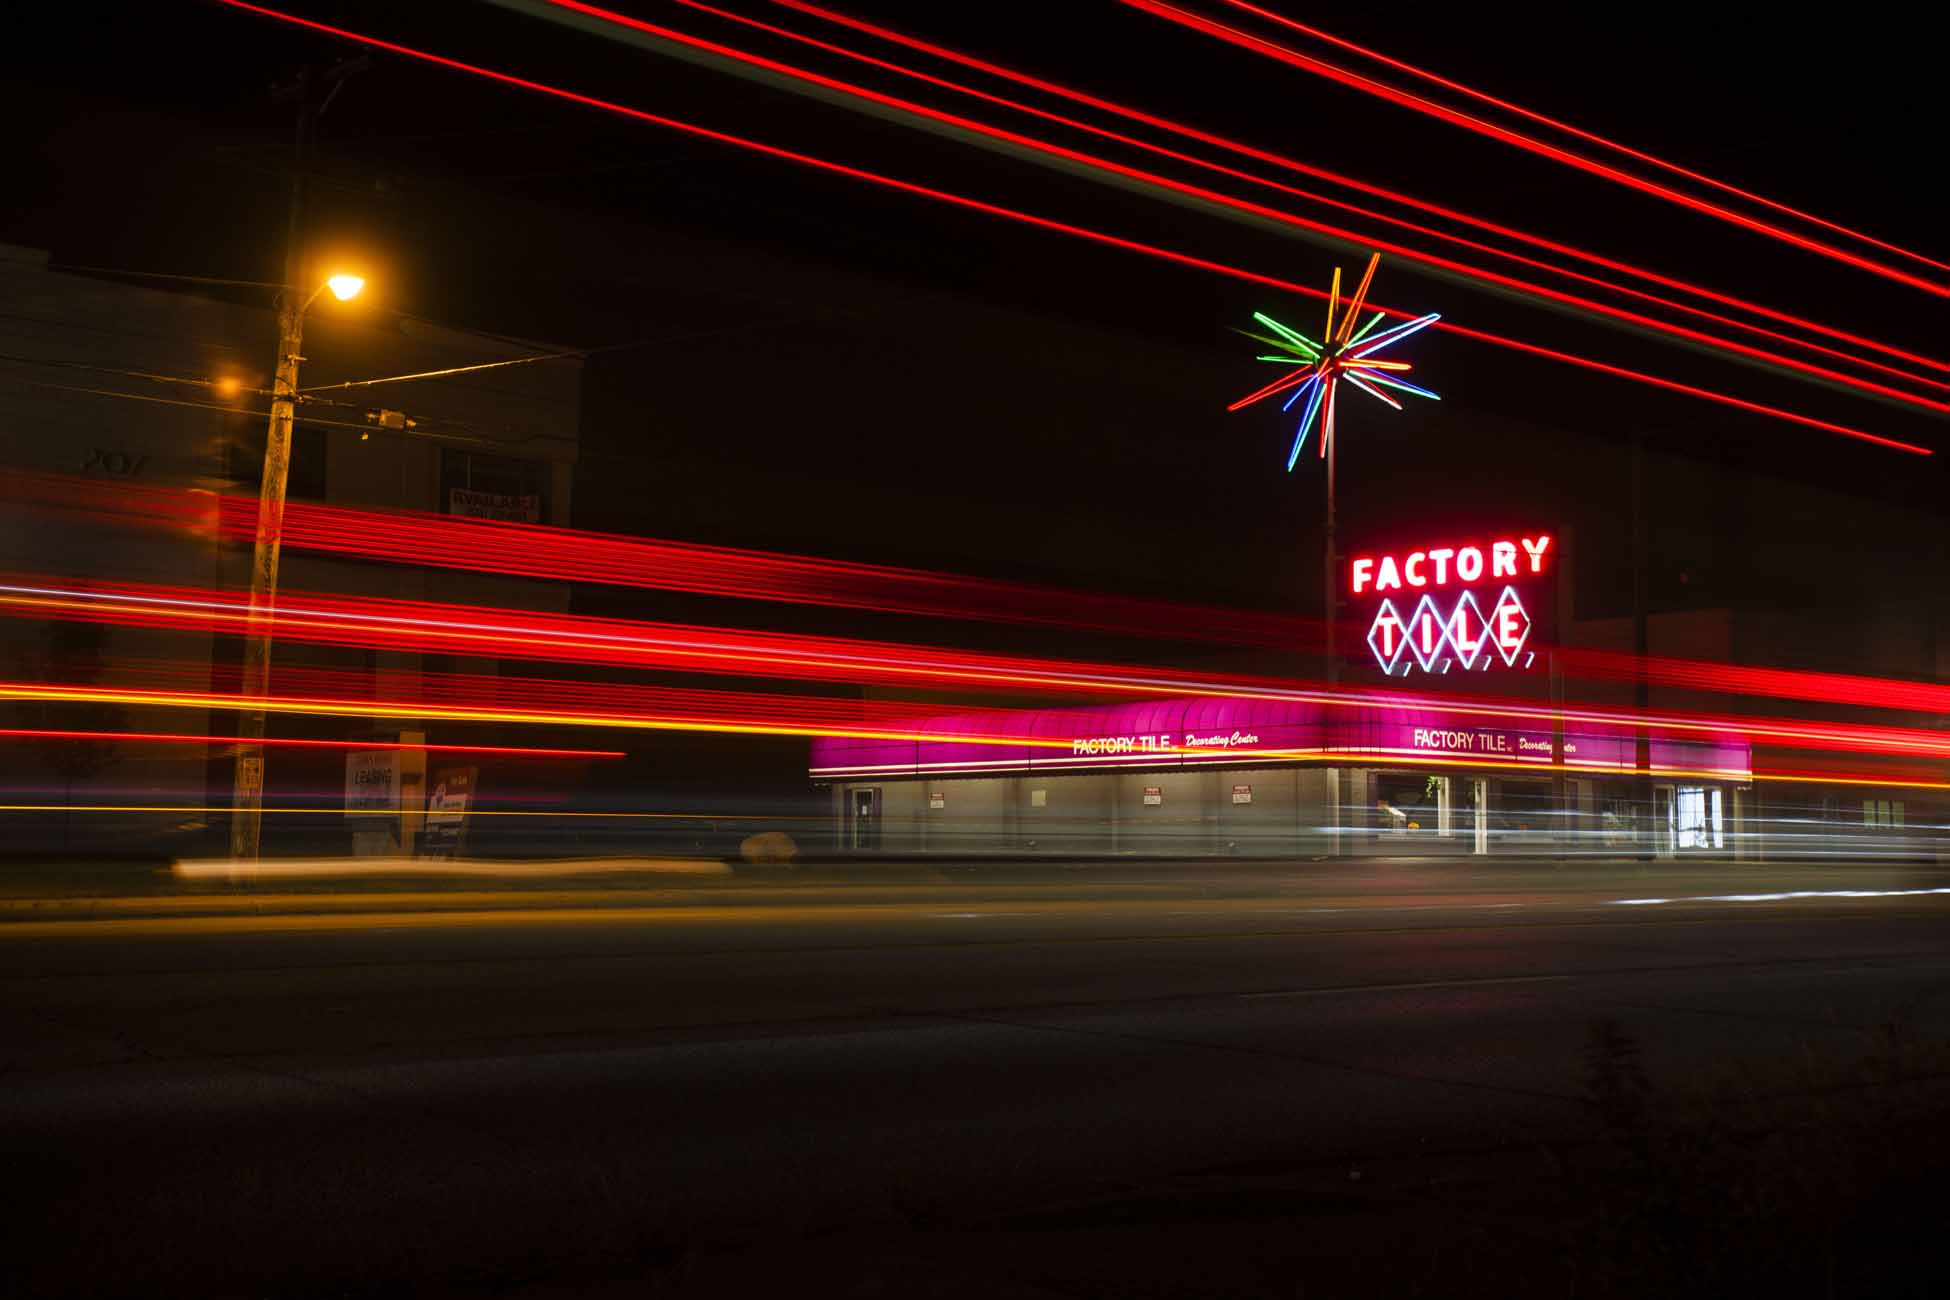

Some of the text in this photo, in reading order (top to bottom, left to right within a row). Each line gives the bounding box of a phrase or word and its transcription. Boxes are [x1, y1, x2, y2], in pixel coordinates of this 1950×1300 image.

[1352, 535, 1550, 593] FACTORY
[1377, 604, 1521, 657] TILE
[1073, 731, 1259, 755] FACTORY TILE Decorating Center
[1414, 729, 1474, 750] FACTORY
[1478, 733, 1506, 752] TILE
